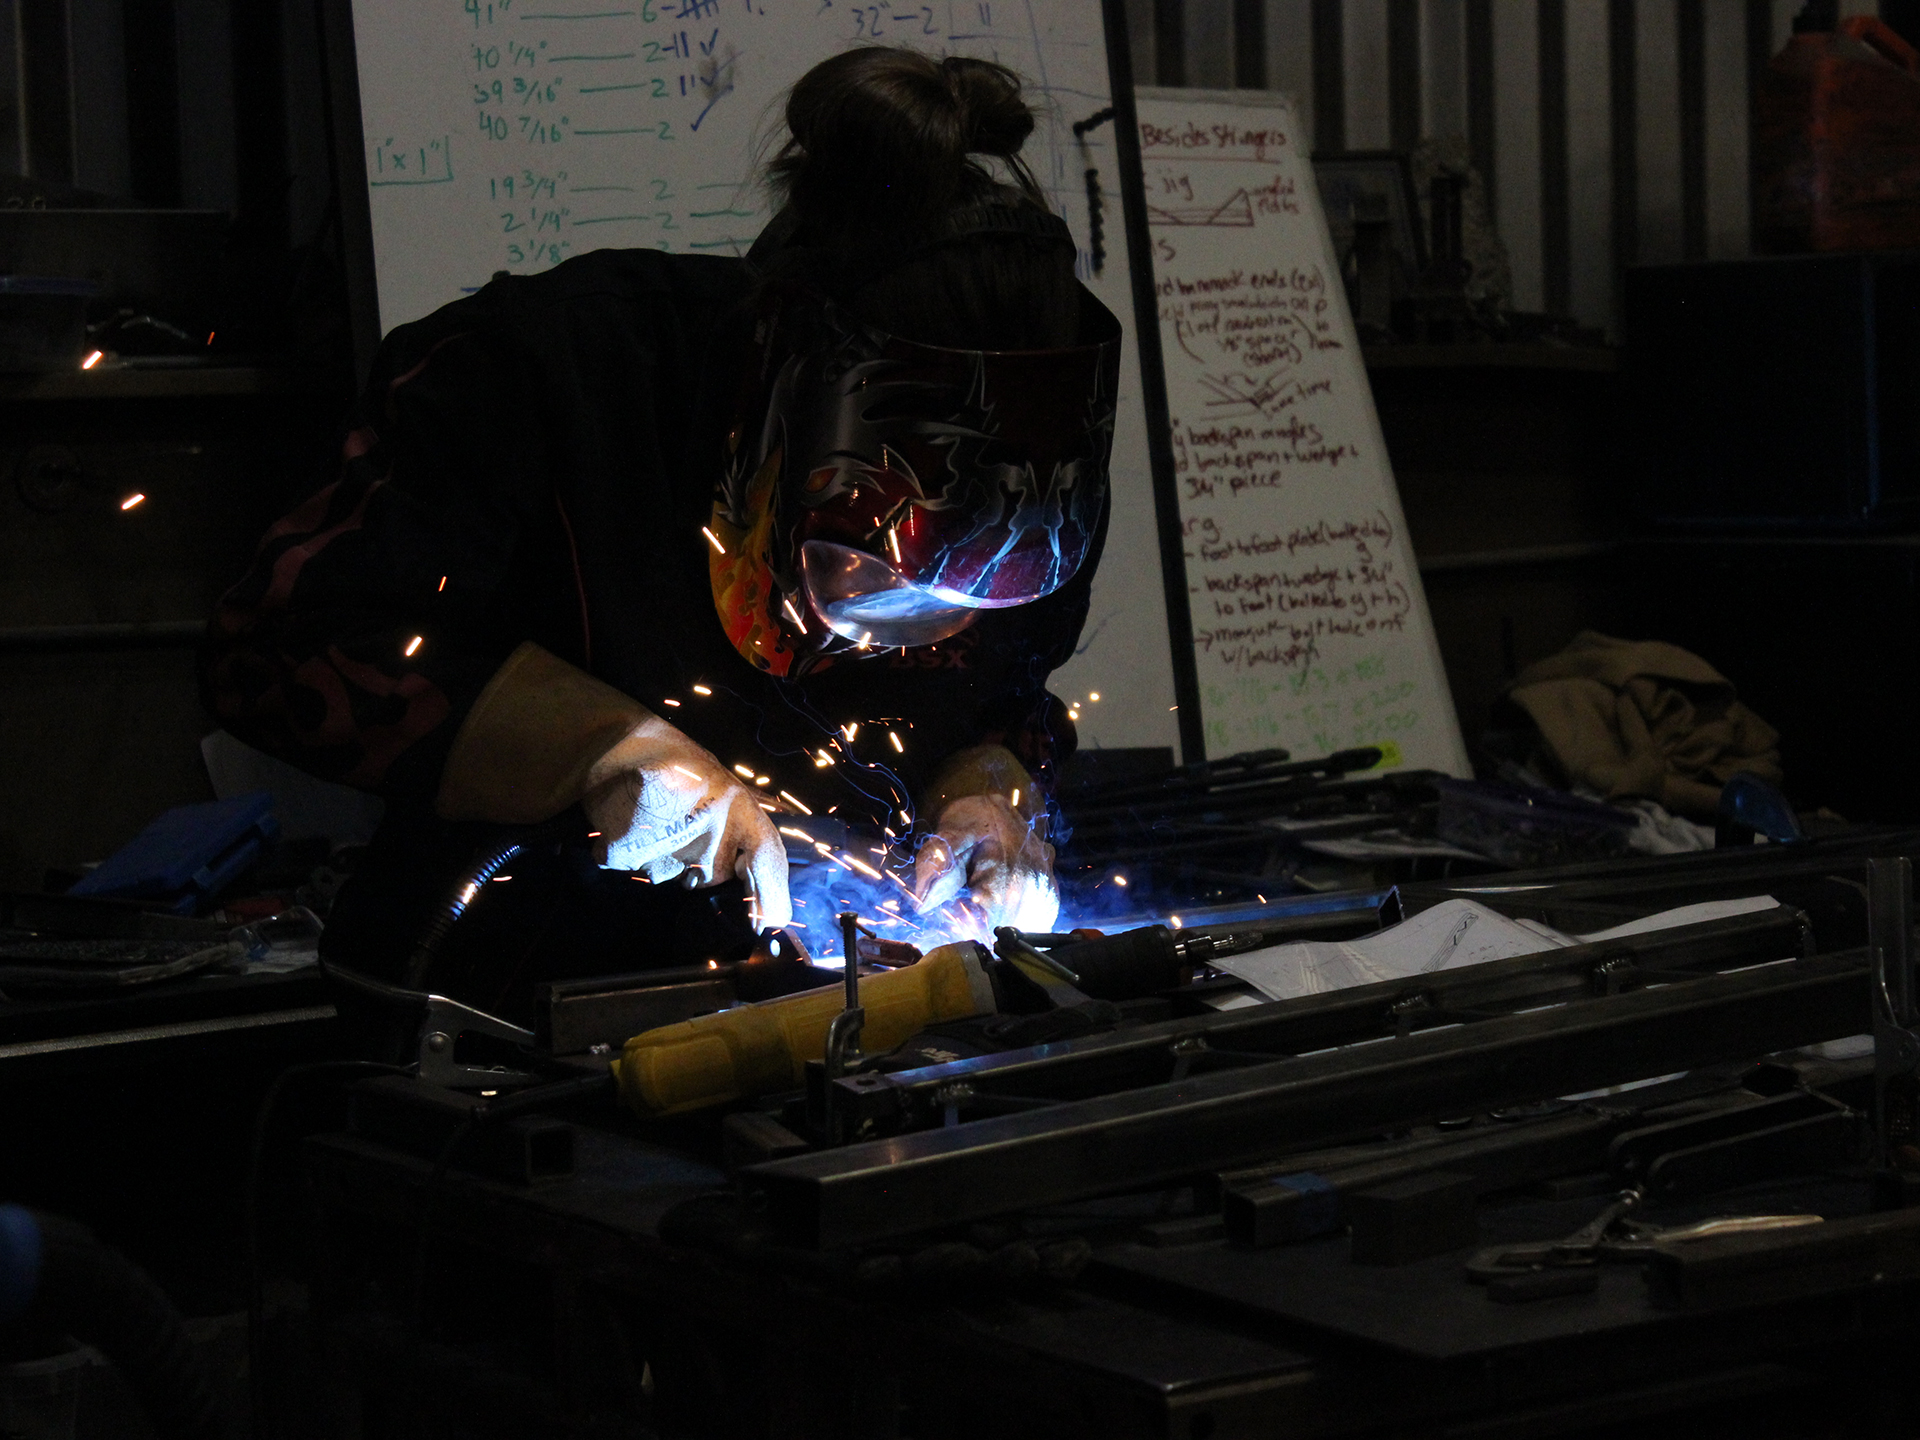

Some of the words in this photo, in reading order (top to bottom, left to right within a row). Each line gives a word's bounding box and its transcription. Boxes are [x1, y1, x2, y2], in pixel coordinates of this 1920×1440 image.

[651, 79, 669, 98] 2
[478, 111, 509, 143] 40
[657, 122, 675, 140] 2
[490, 176, 514, 199] 19
